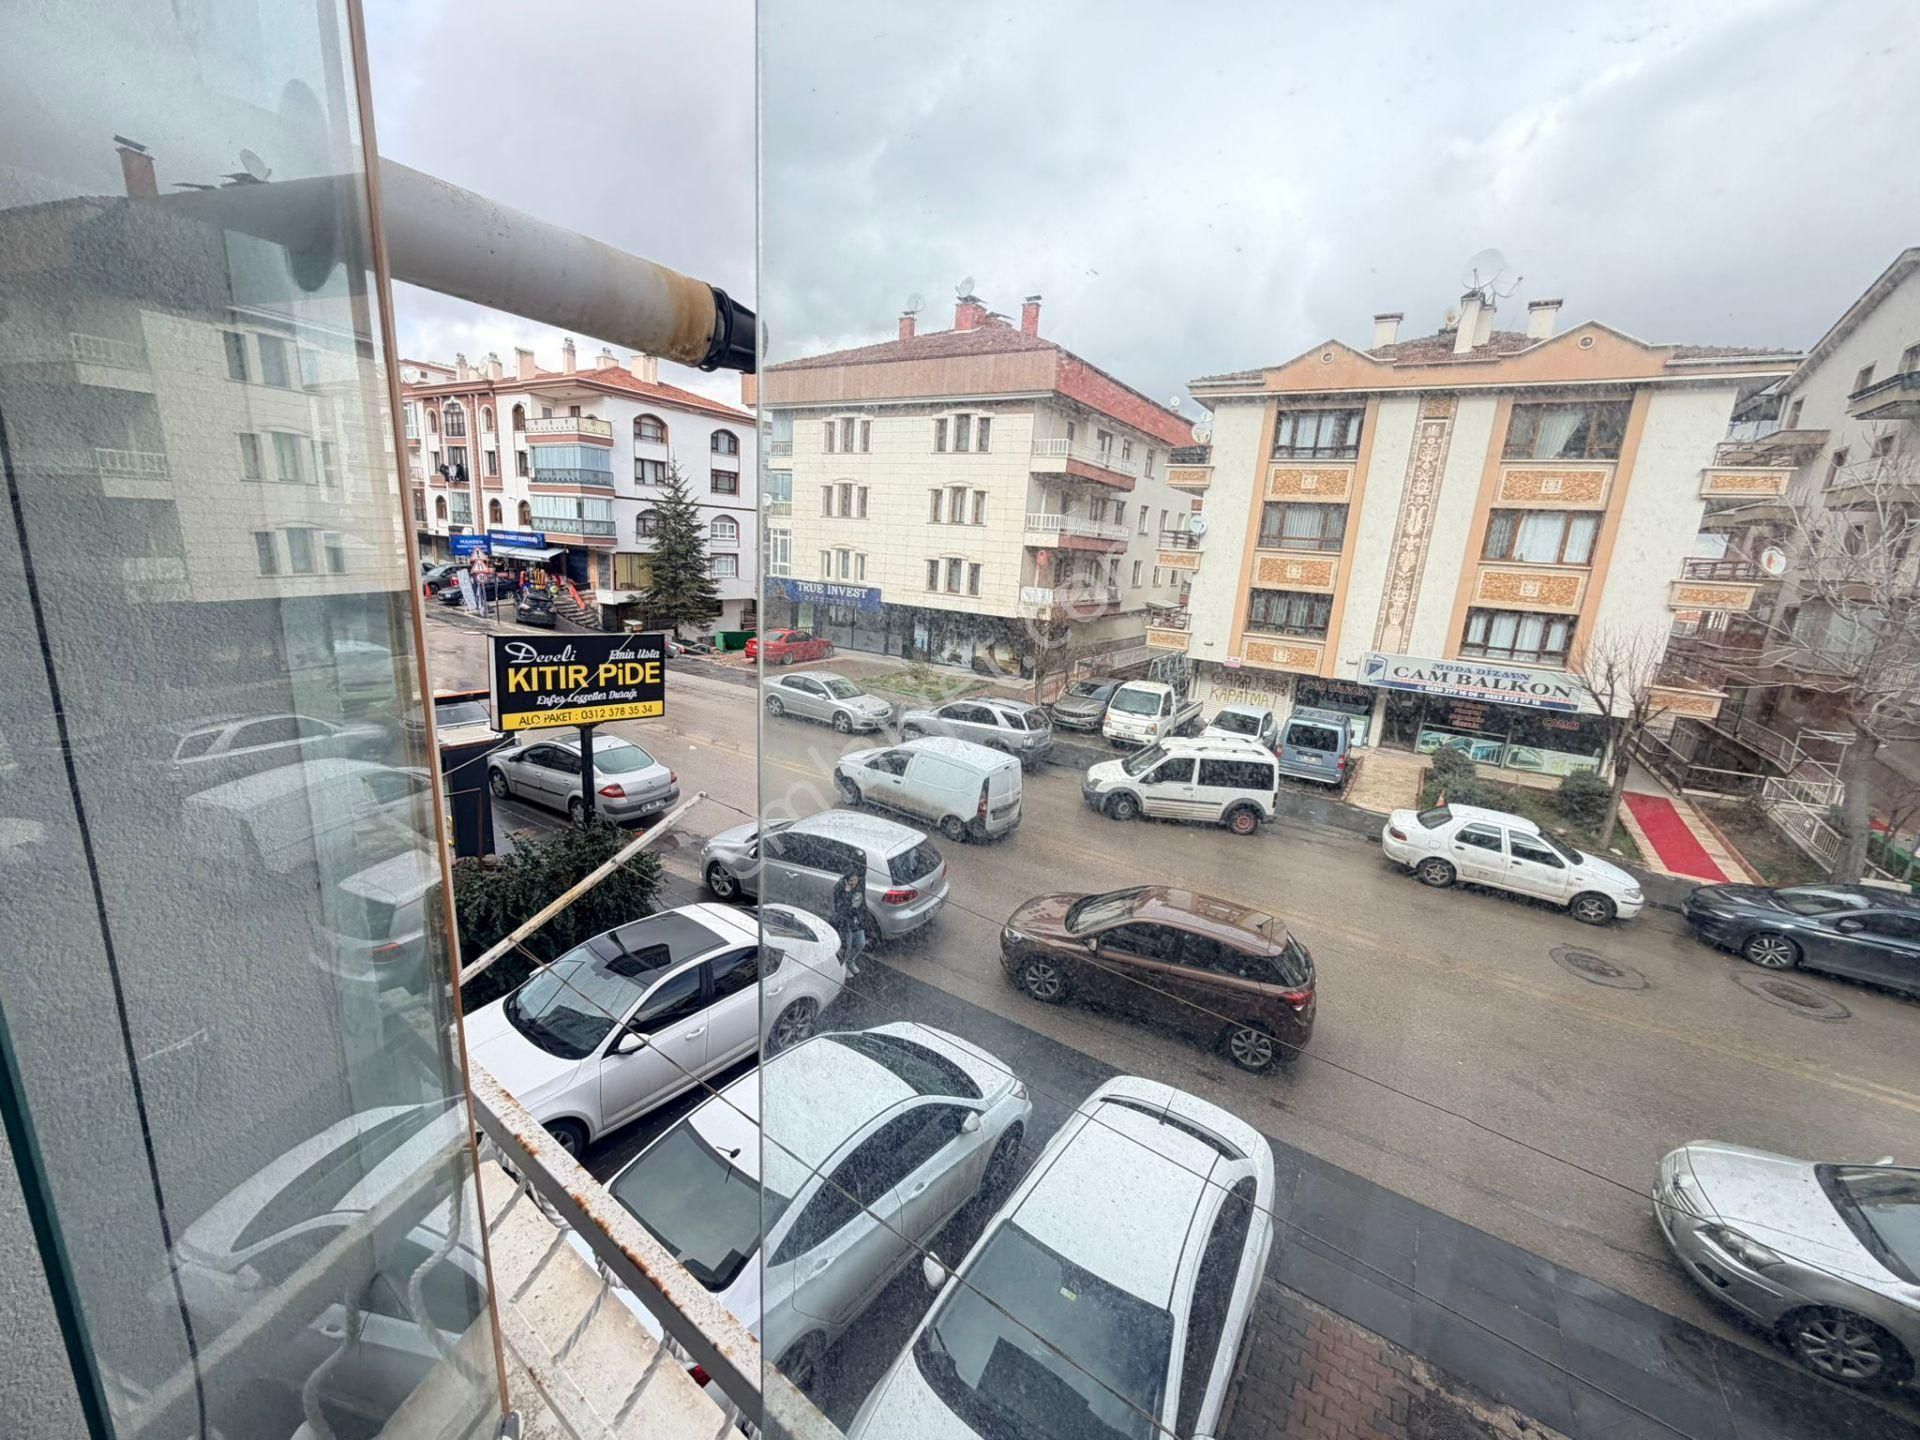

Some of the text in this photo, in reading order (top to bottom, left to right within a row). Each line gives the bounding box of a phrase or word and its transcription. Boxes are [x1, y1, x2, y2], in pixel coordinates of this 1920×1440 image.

[797, 581, 868, 599] TRUE INVEST
[504, 642, 576, 664] Develi
[608, 648, 660, 660] Emin Usta
[507, 665, 589, 693] KITIR
[1393, 665, 1448, 684] CAM
[1456, 674, 1574, 698] BALKON
[1209, 686, 1269, 706] KAPATMA
[518, 714, 541, 726] ALO
[544, 711, 572, 724] PAKET
[581, 708, 606, 720] 0312
[608, 706, 626, 717] 378
[628, 705, 640, 715] 35
[641, 704, 653, 714] 34
